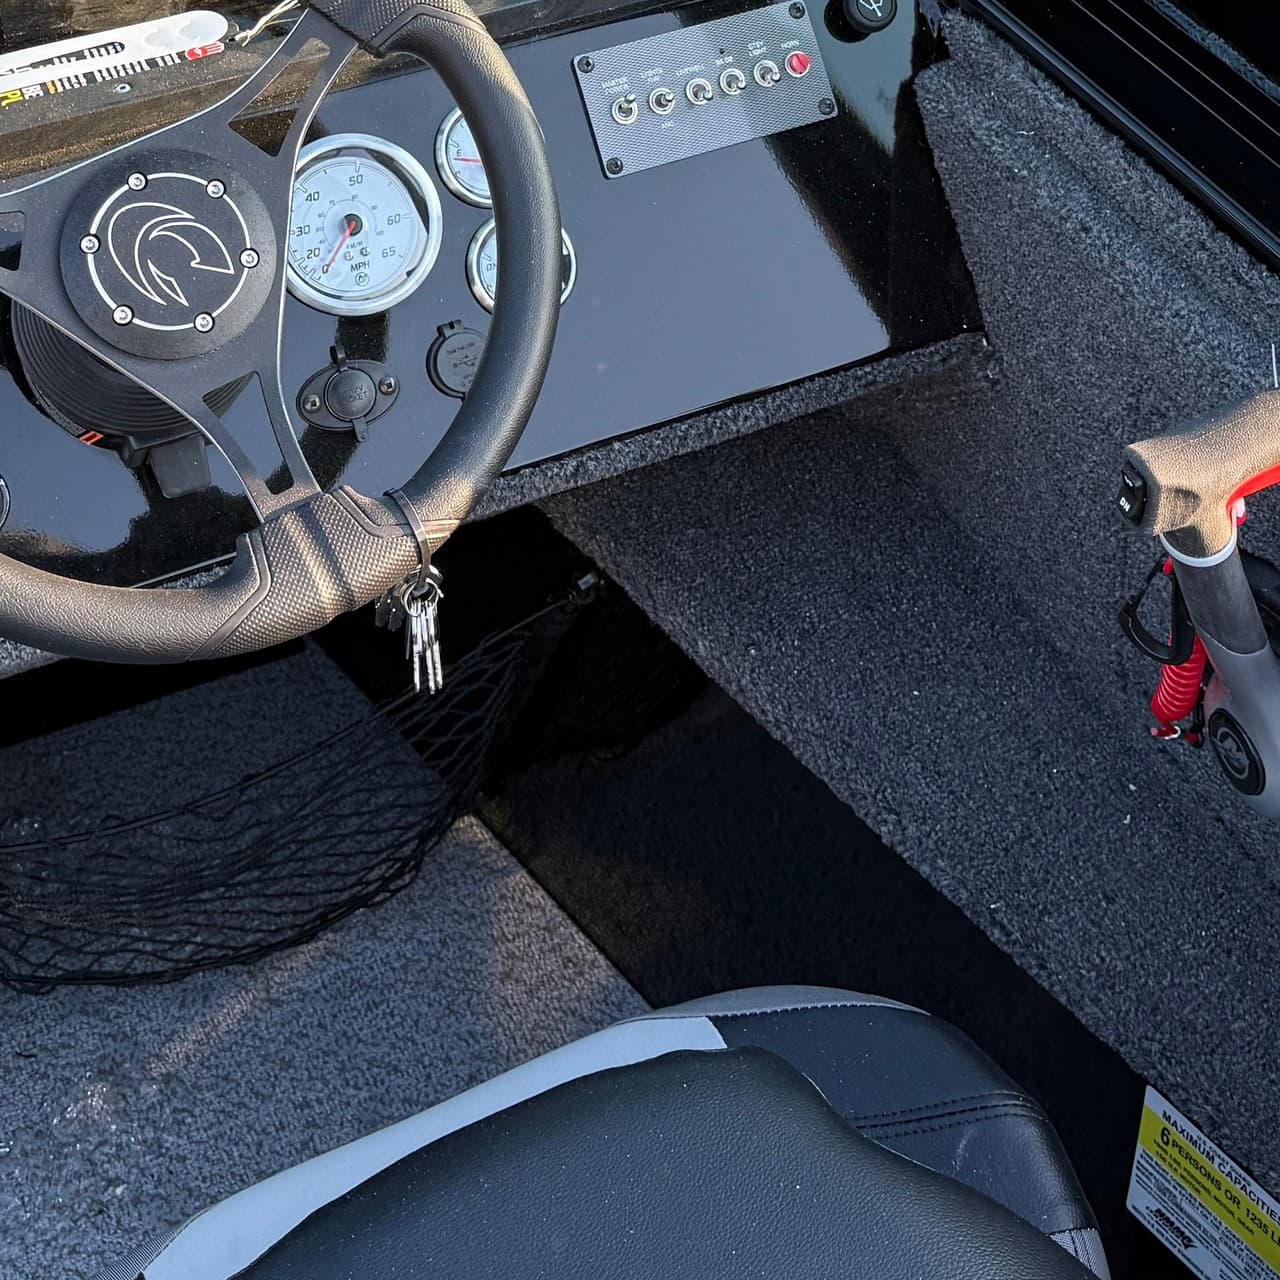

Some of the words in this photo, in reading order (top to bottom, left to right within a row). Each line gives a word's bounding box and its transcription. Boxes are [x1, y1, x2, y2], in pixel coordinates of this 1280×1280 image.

[349, 174, 363, 187] 50
[305, 191, 320, 203] 40
[387, 213, 401, 226] 60
[296, 224, 311, 238] 30
[306, 247, 321, 259] 20
[381, 246, 396, 259] 65
[350, 260, 370, 273] MPH
[1119, 497, 1131, 513] DN
[1161, 1108, 1215, 1165] MAXIMUM
[1159, 1123, 1171, 1148] 6
[1170, 1137, 1222, 1192] PERSONS
[1223, 1186, 1241, 1210] OR
[1244, 1206, 1269, 1236] 1235
